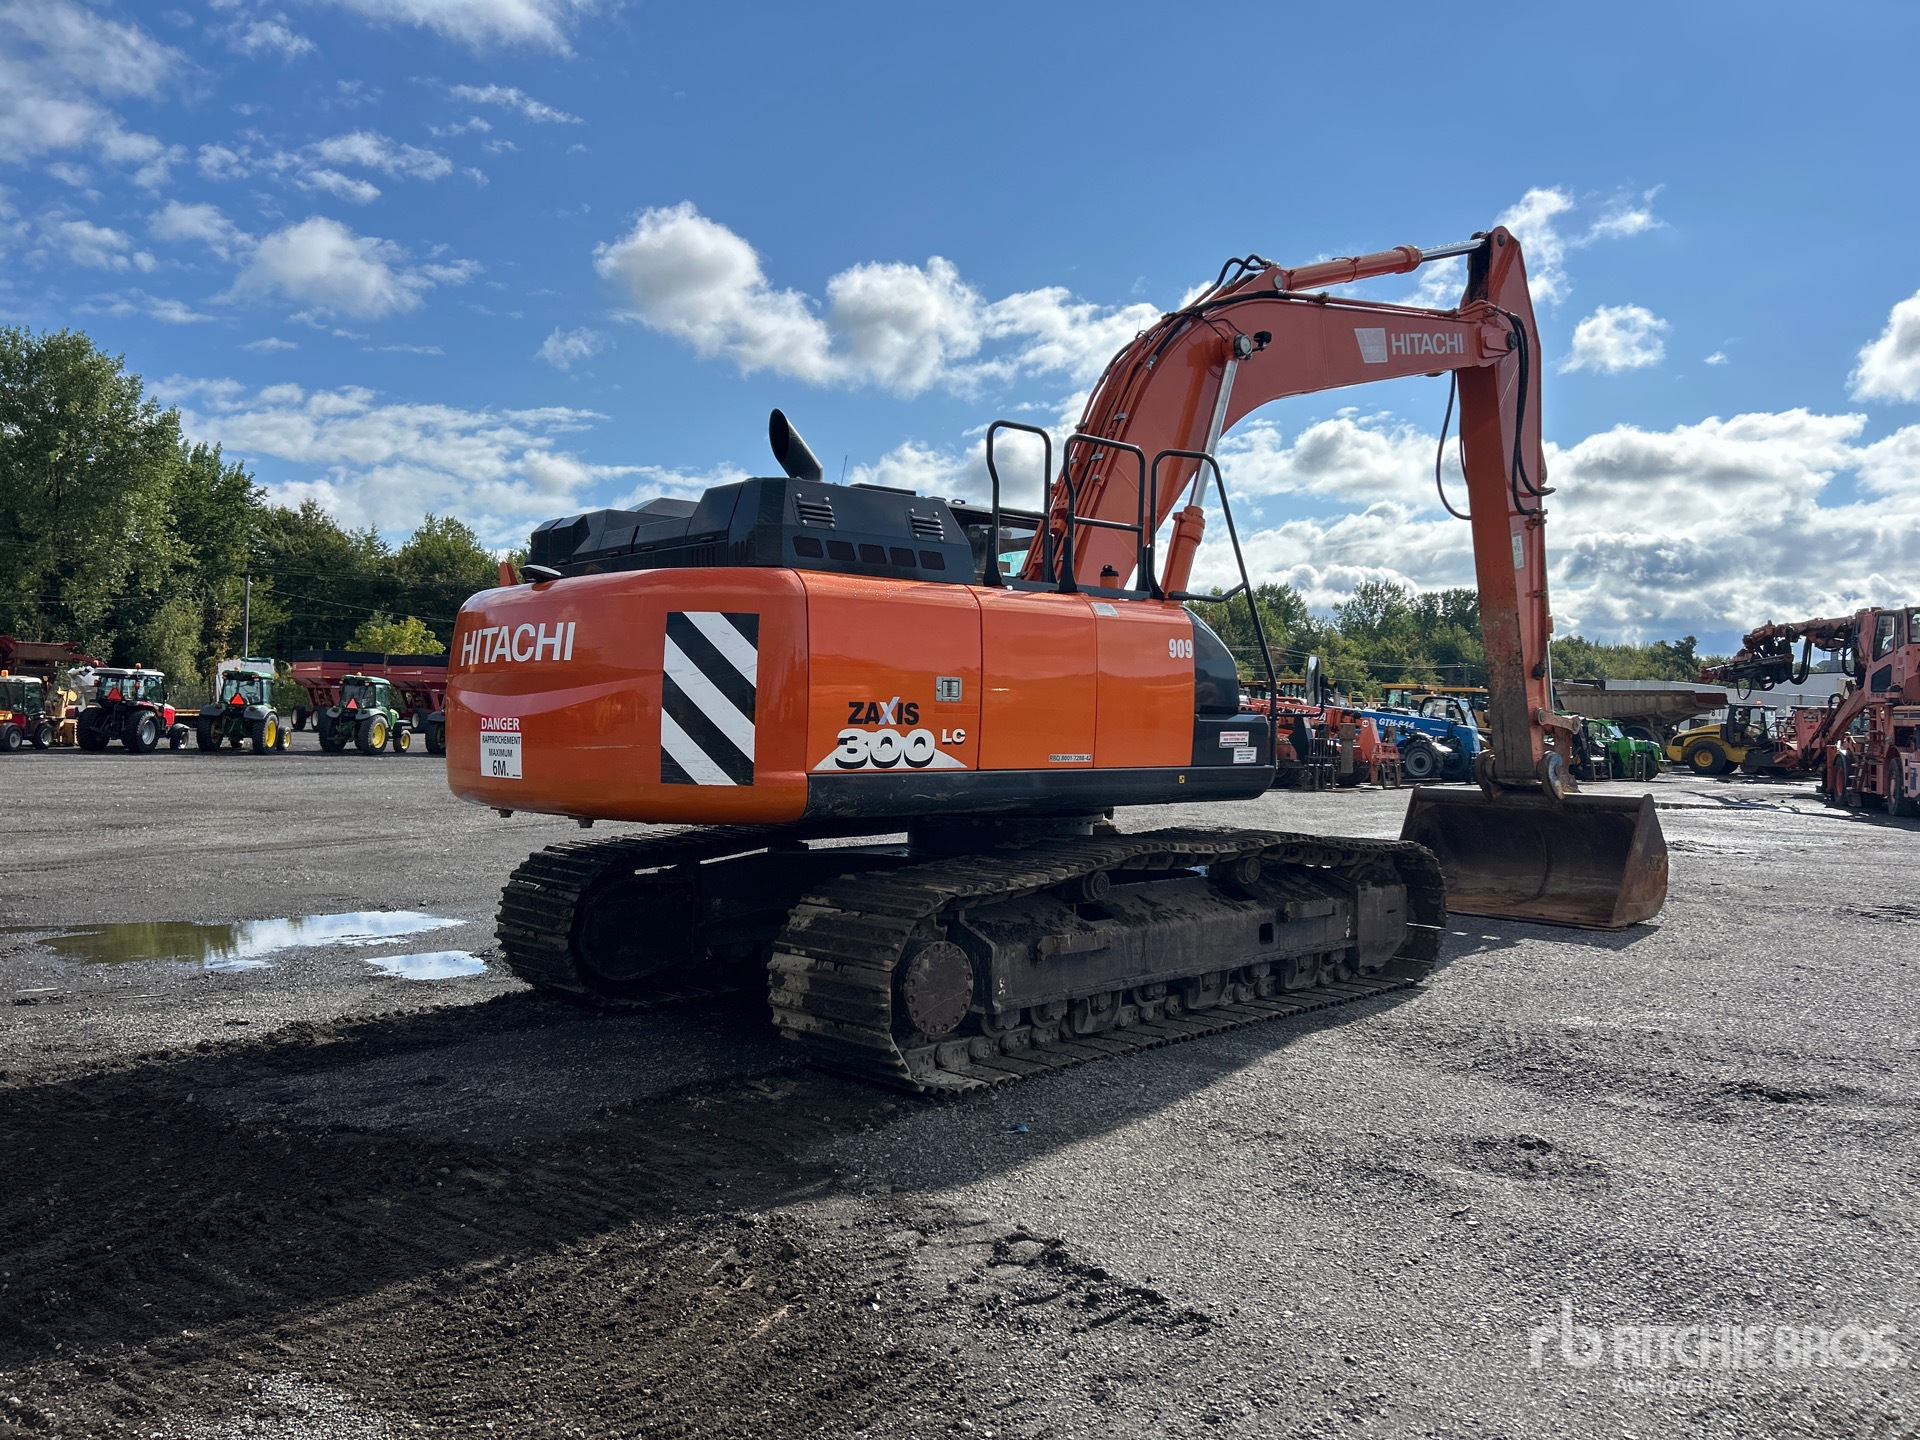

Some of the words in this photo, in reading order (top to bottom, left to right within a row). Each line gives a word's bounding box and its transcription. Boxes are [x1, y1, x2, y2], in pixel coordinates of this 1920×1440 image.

[1391, 333, 1464, 355] HITACHI
[460, 622, 576, 666] HITACHI
[1168, 638, 1193, 659] 909
[848, 696, 920, 725] ZAXIS
[481, 717, 520, 731] DANGER
[1378, 717, 1415, 730] GTH-844
[482, 735, 521, 745] RAPPROCHEMENT
[835, 728, 936, 769] 300
[942, 728, 966, 745] LC
[488, 748, 513, 758] MAXIMUM
[492, 759, 509, 777] 6M.
